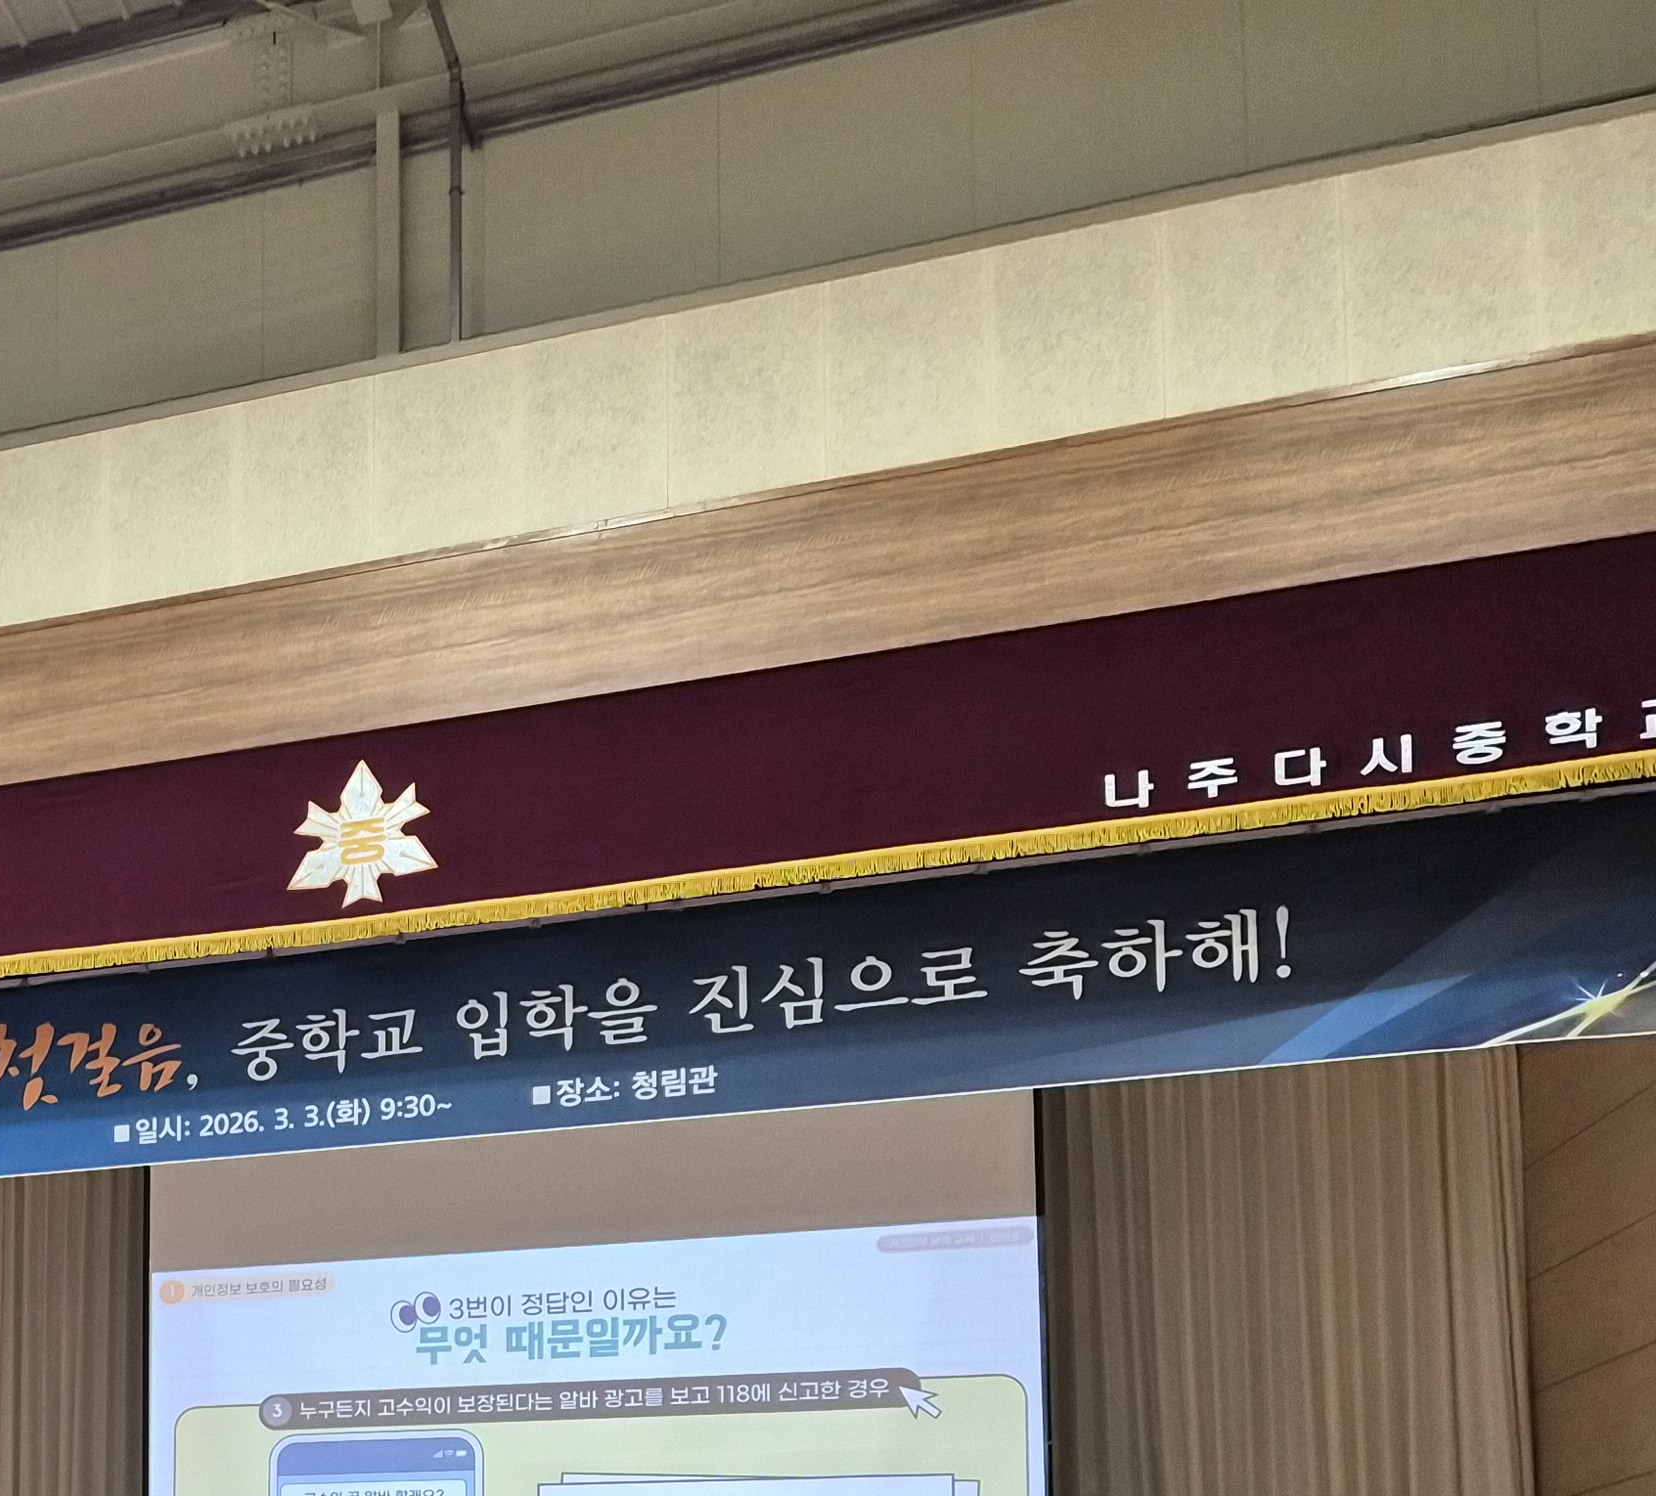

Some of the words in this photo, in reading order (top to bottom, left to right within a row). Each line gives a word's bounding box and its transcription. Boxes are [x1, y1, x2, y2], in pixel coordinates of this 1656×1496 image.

[230, 1008, 424, 1082] 중학교
[456, 977, 658, 1060] 입학을
[688, 947, 988, 1034] 진심으로
[1018, 905, 1292, 1001] 축하해!
[556, 1076, 620, 1108] 장소:
[631, 1064, 719, 1101] 청림관
[135, 1114, 191, 1145] 일시:
[199, 1110, 265, 1137] 2026.
[274, 1107, 295, 1130] 3.
[304, 1097, 371, 1128] 3.(화)
[379, 1093, 452, 1121] 9:30~
[191, 1283, 242, 1298] 개인정보
[246, 1280, 284, 1295] 보호의
[449, 1294, 512, 1320] 3번이
[521, 1290, 593, 1316] 정답인
[603, 1286, 677, 1311] 이유는
[414, 1321, 487, 1366] 무엇
[505, 1312, 728, 1361] 때문일까요?
[272, 1403, 283, 1418] 3
[300, 1399, 371, 1420] 누구든지
[377, 1396, 451, 1417] 고수익이
[458, 1392, 553, 1413] 보장된다는
[559, 1390, 598, 1410] 알바
[604, 1387, 663, 1408] 광고를
[670, 1386, 710, 1405] 보고
[717, 1383, 771, 1404] 118에
[778, 1380, 841, 1402] 신고한
[848, 1378, 890, 1399] 경우
